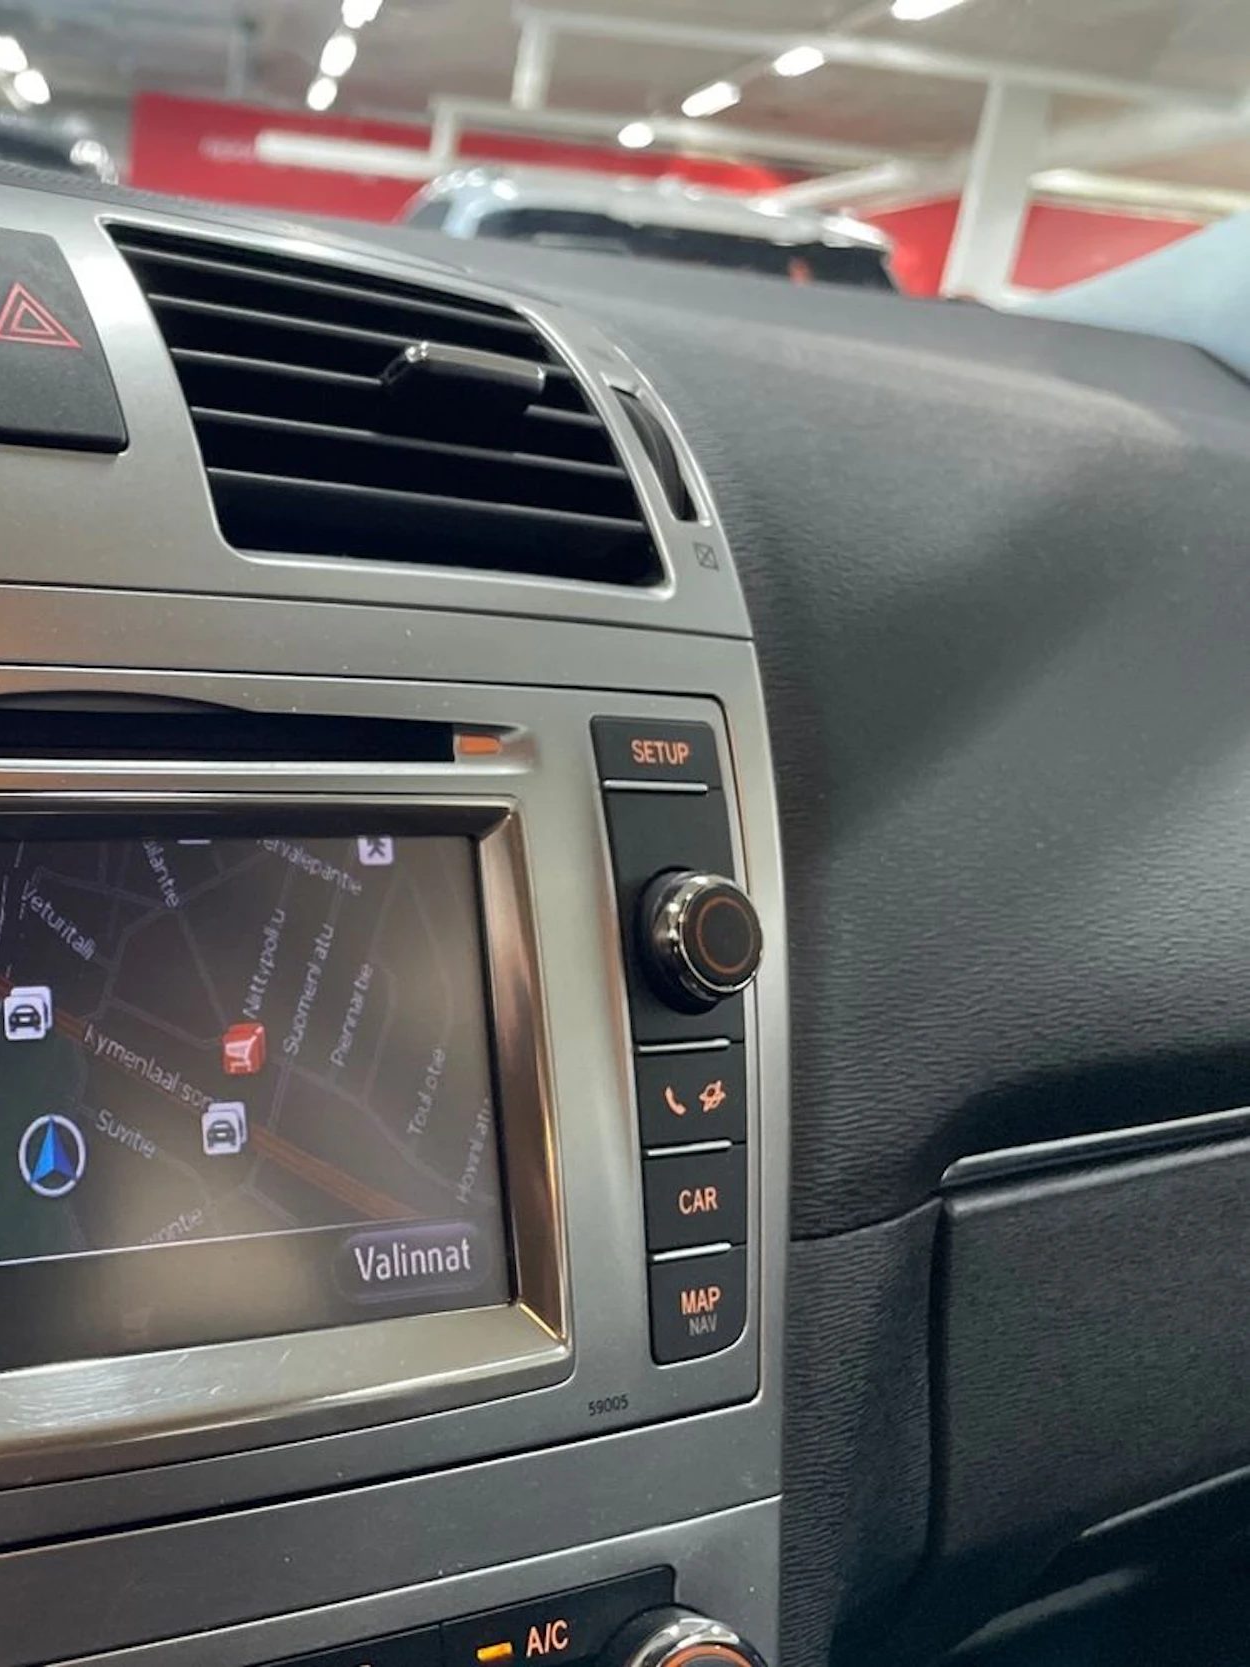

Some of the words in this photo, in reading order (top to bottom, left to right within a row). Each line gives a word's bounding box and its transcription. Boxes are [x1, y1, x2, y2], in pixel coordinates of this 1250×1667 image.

[630, 739, 691, 765] SETUP
[678, 1186, 719, 1216] CAR
[353, 1237, 472, 1283] Valinnat
[680, 1285, 722, 1316] MAP
[688, 1314, 718, 1337] NAV
[588, 1395, 630, 1417] 59005
[525, 1618, 570, 1659] A/C
